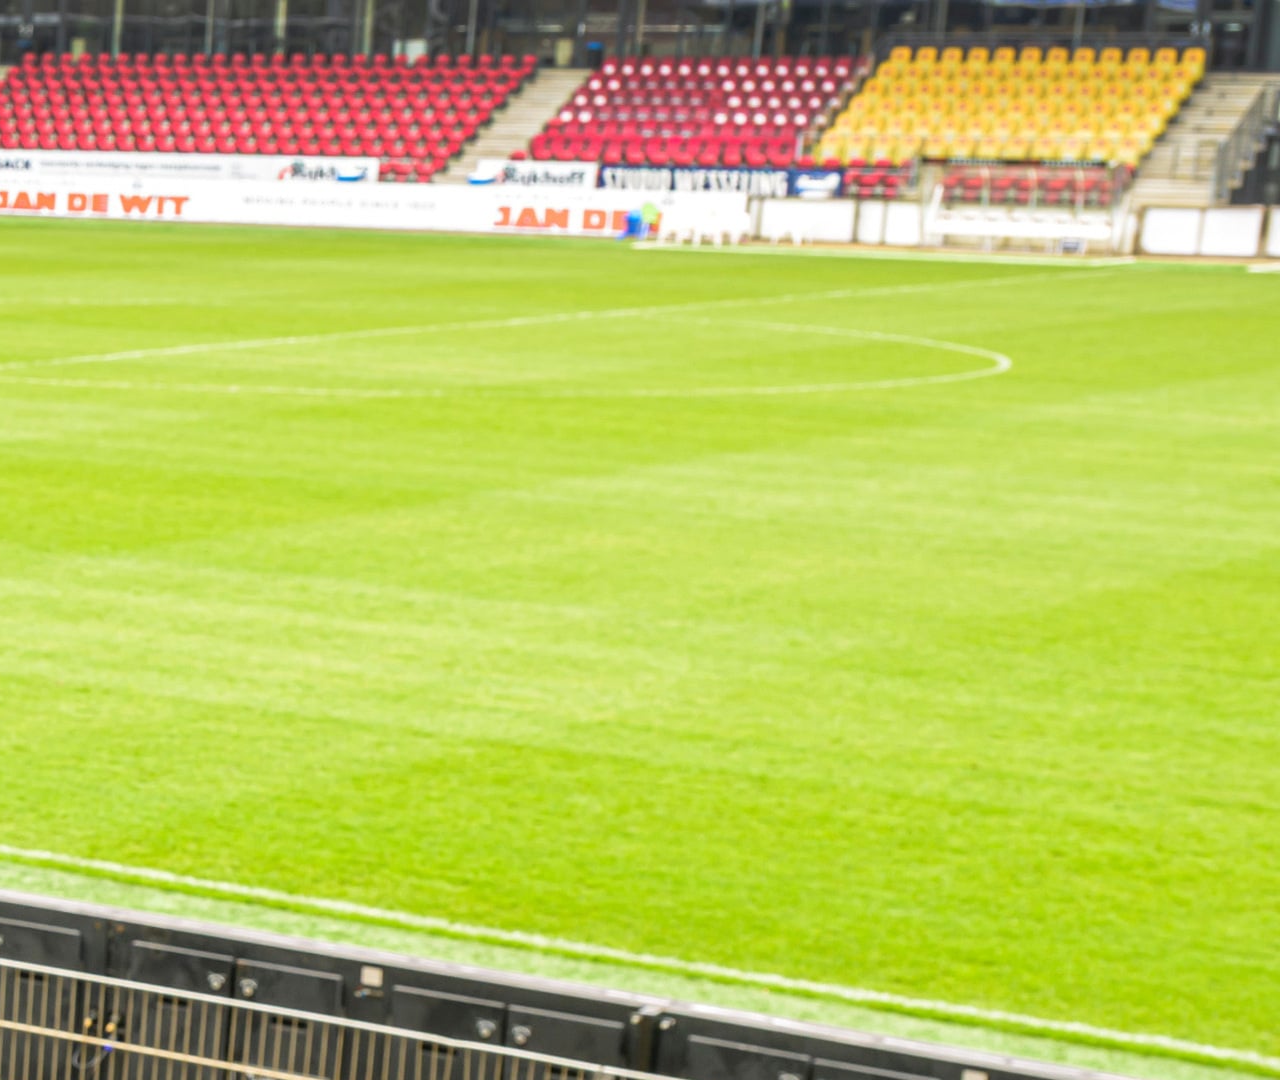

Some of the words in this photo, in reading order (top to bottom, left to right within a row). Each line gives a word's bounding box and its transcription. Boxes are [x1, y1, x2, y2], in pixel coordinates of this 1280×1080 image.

[67, 193, 109, 213] DE
[119, 194, 189, 216] WIT
[495, 206, 570, 230] JAN
